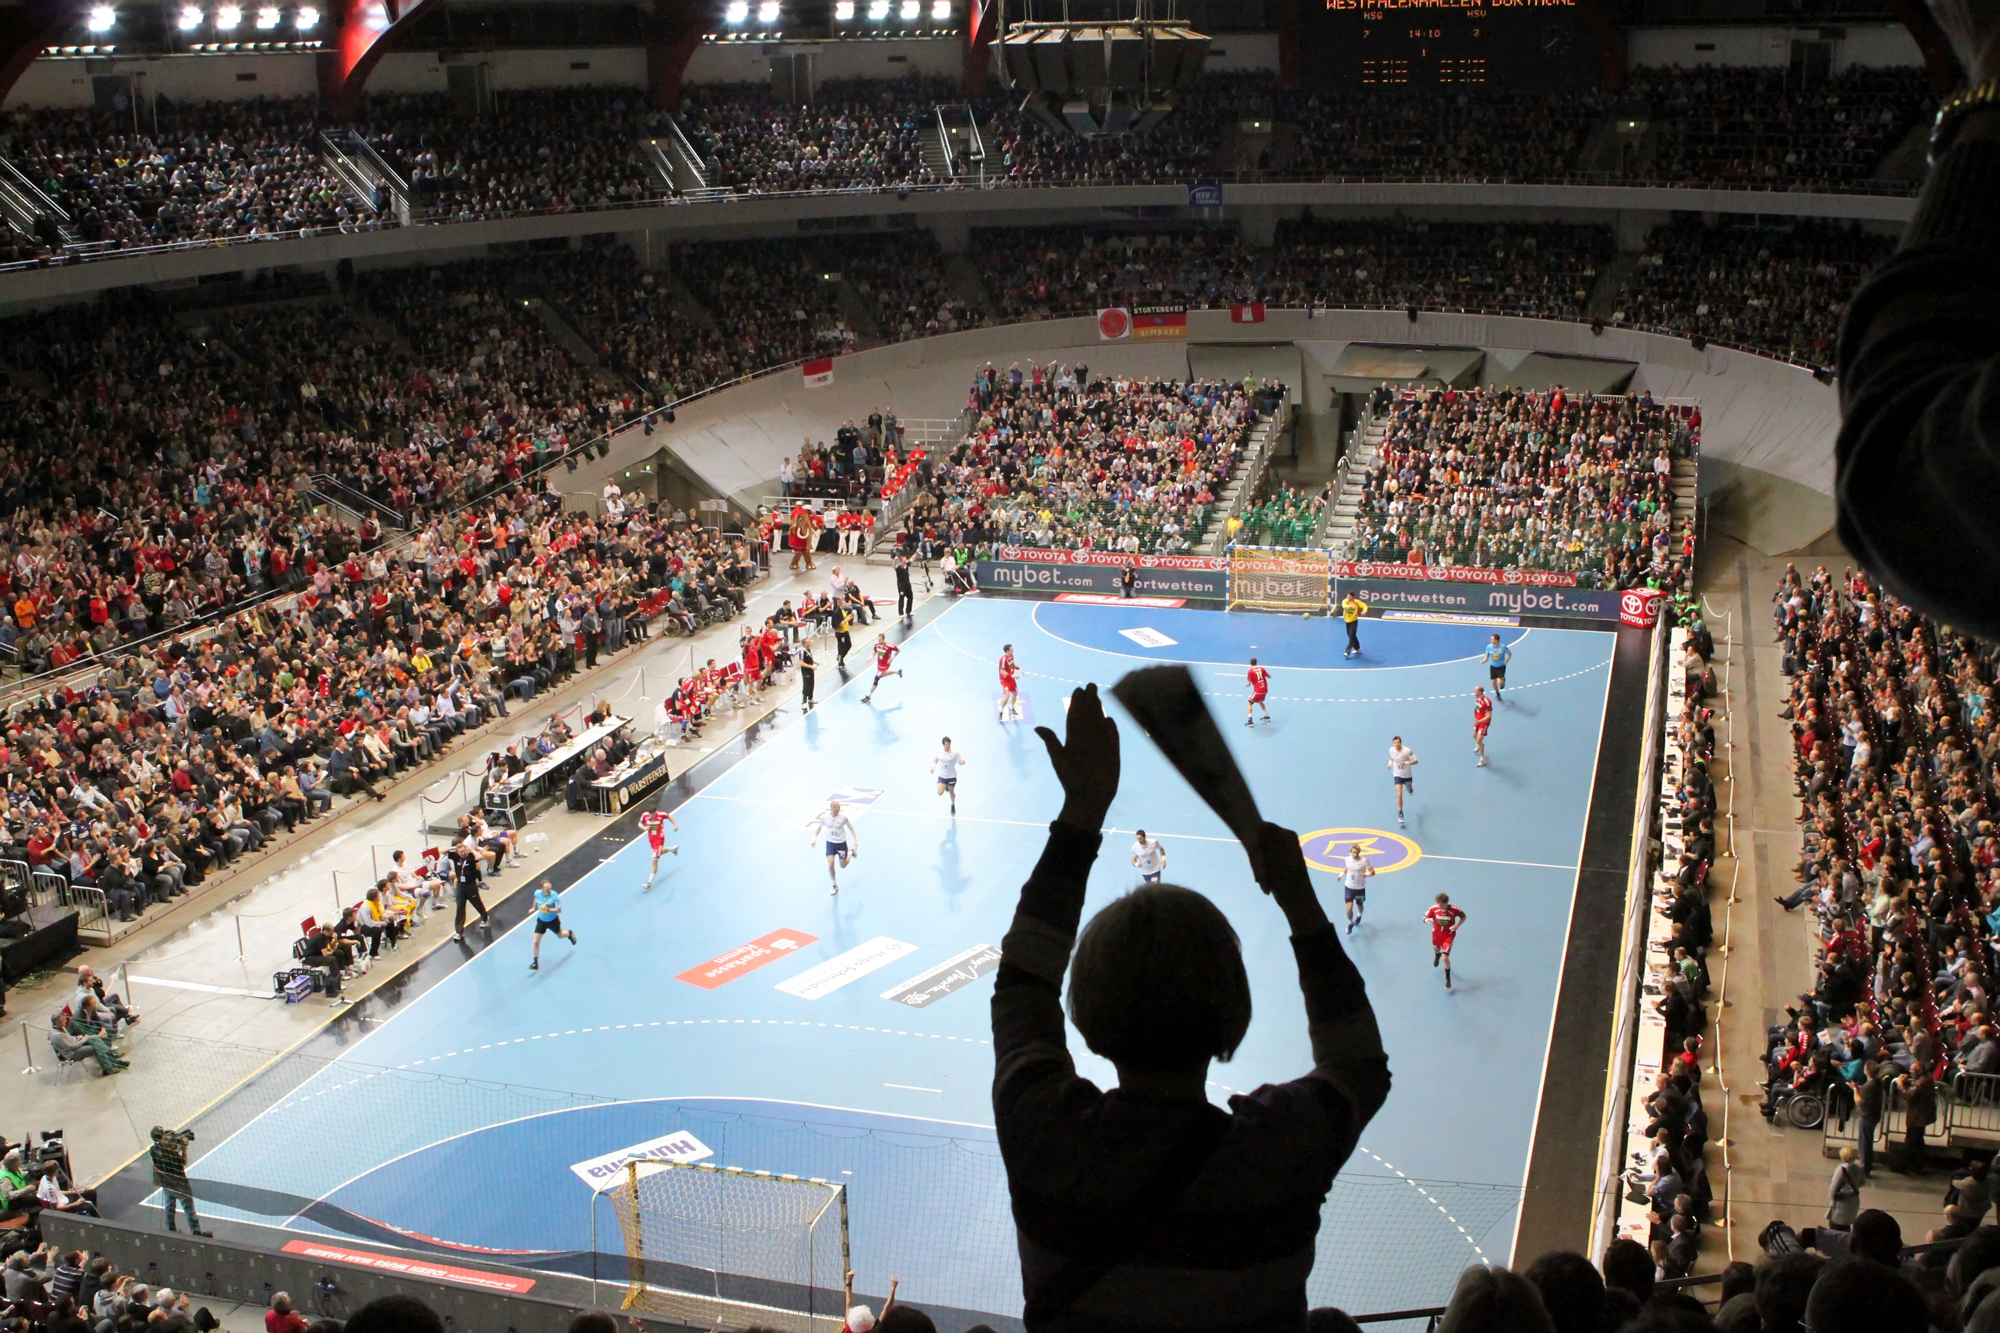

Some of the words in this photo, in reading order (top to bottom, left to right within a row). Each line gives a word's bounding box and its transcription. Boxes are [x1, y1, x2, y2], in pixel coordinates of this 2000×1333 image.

[1363, 11, 1383, 20] HSG
[1467, 9, 1487, 18] HSV
[1363, 30, 1370, 39] 7
[1409, 29, 1441, 38] 14:10
[1022, 550, 1067, 561] TOYOTA
[1091, 554, 1135, 565] TOYOTA
[1160, 558, 1205, 568] TOYOTA
[1230, 561, 1276, 571] TOYOTA
[1375, 566, 1423, 577] TOYOTA
[1449, 569, 1498, 581] TOYOTA
[1524, 573, 1573, 584] TOYOTA
[994, 564, 1093, 588] mybet.com
[1112, 577, 1214, 593] Sortwetten
[1359, 589, 1467, 605] Sportwetten
[1488, 588, 1599, 613] mybet.com
[1620, 612, 1644, 625] TOYOTA
[628, 763, 668, 796] WARSTEINER
[714, 943, 758, 964] Hamm
[855, 951, 888, 967] Hugo
[705, 947, 771, 978] Sparkasse
[798, 961, 857, 995] Schneider
[304, 1248, 347, 1262] HABEN
[345, 1254, 373, 1265] MAN
[374, 1259, 410, 1272] MUSS
